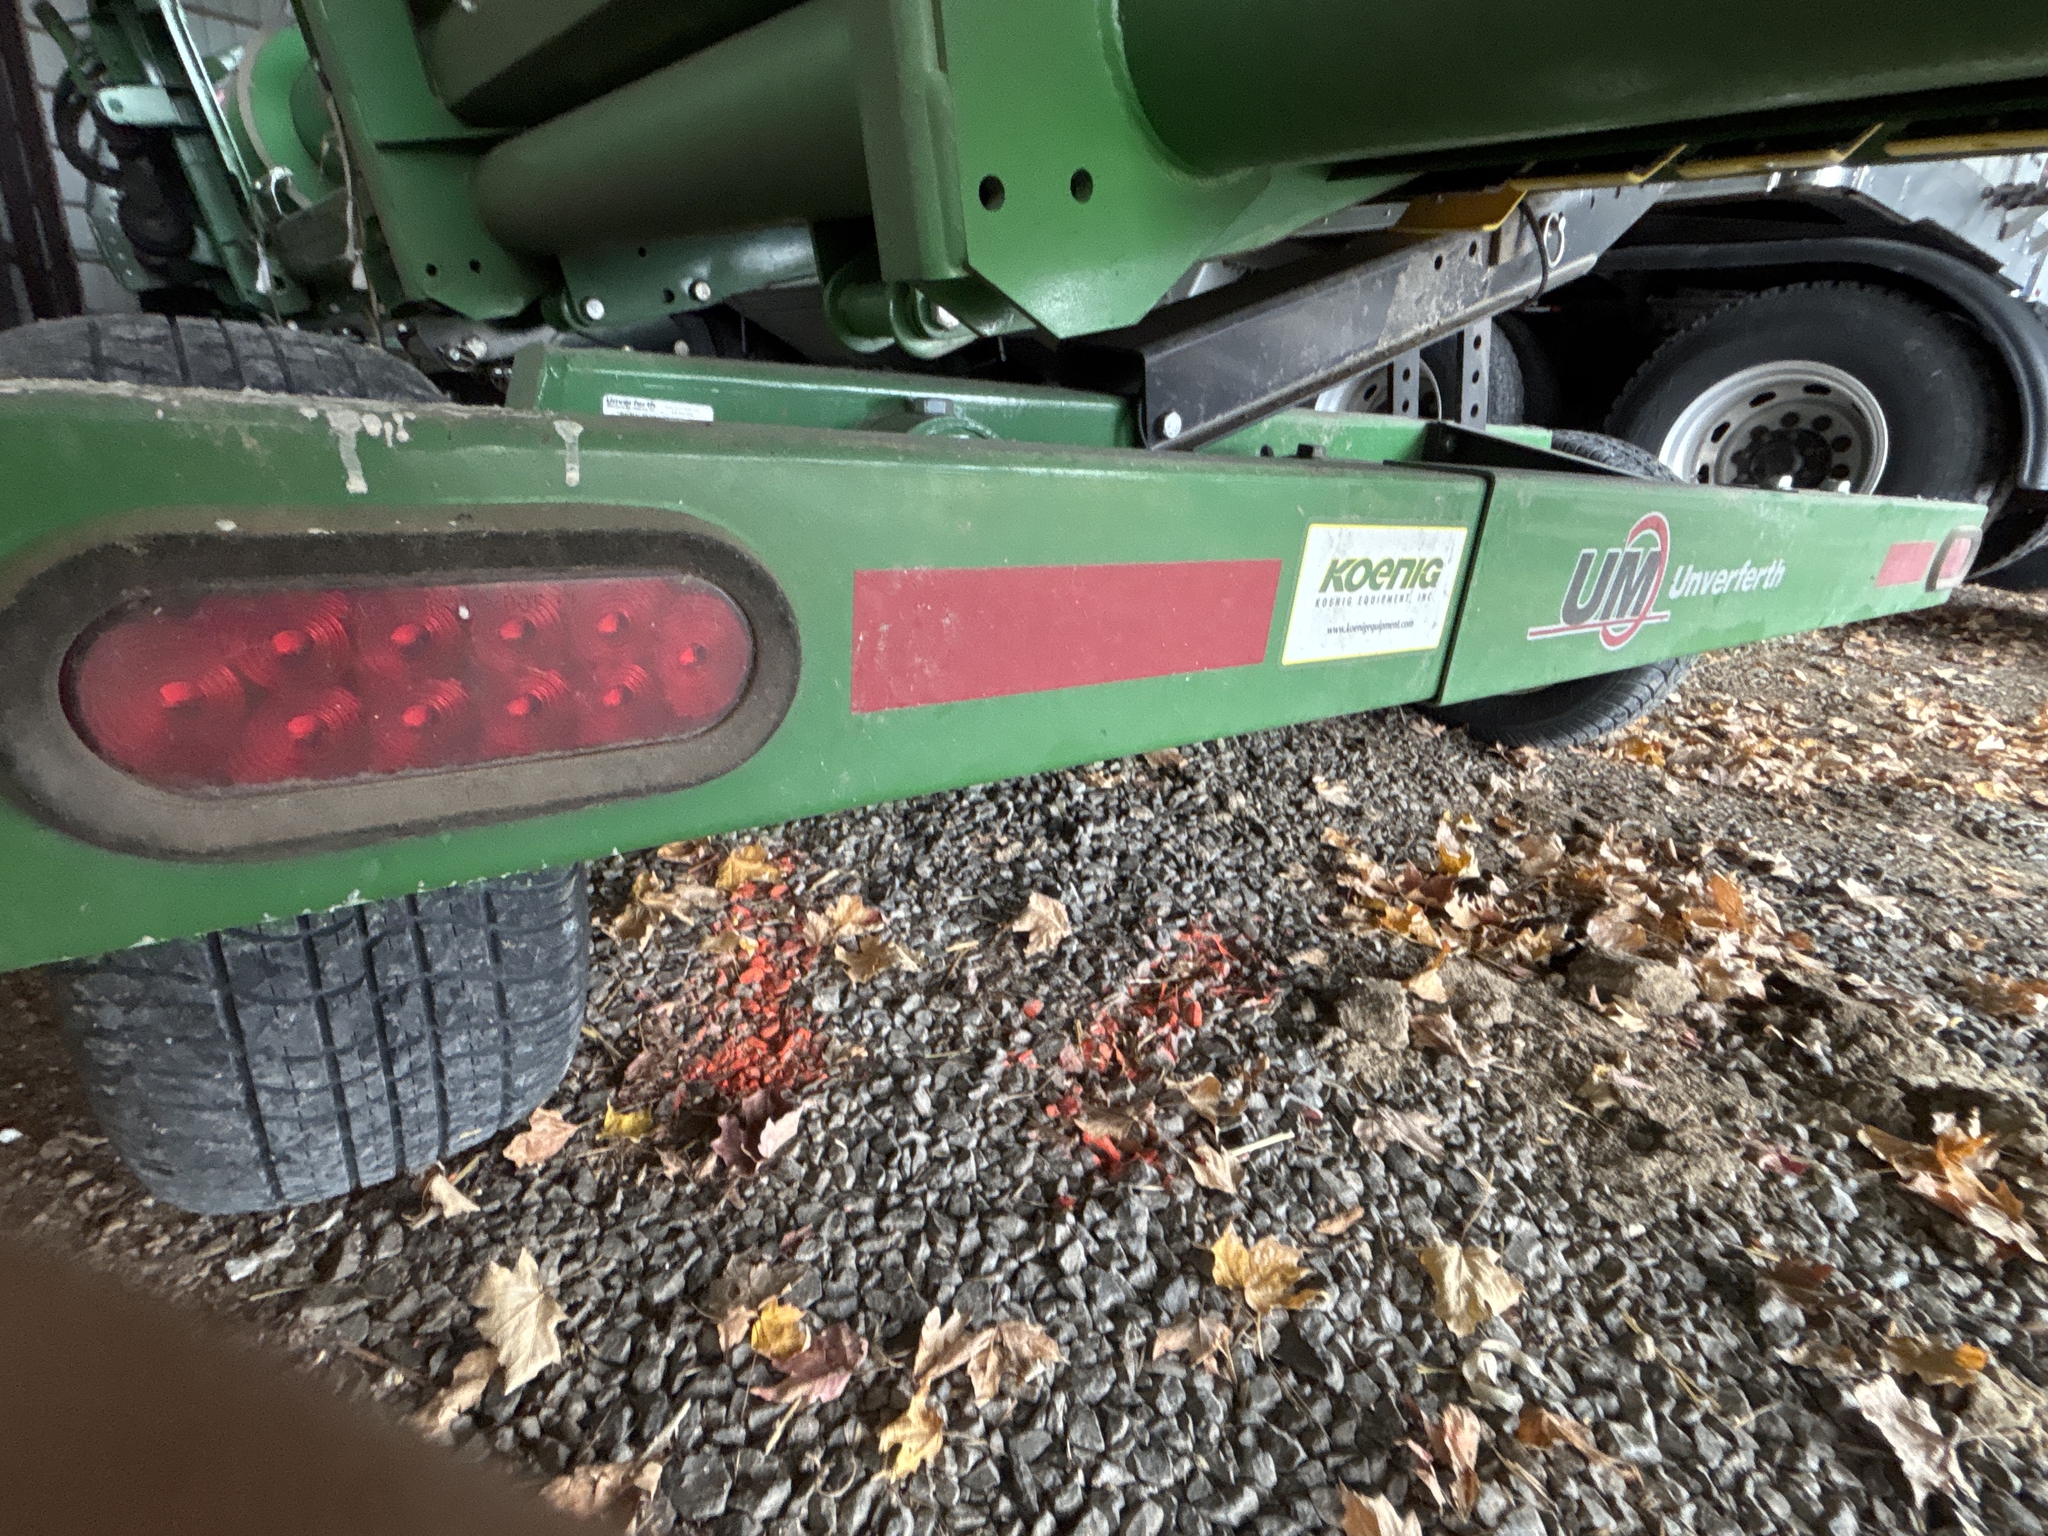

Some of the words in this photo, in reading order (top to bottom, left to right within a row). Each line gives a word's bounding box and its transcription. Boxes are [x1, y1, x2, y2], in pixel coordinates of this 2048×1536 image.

[1560, 548, 1663, 626] UM
[1669, 559, 1786, 599] Unverferth
[1315, 595, 1353, 608] KOENIG
[1327, 619, 1414, 635] www.koenigequipment.com
